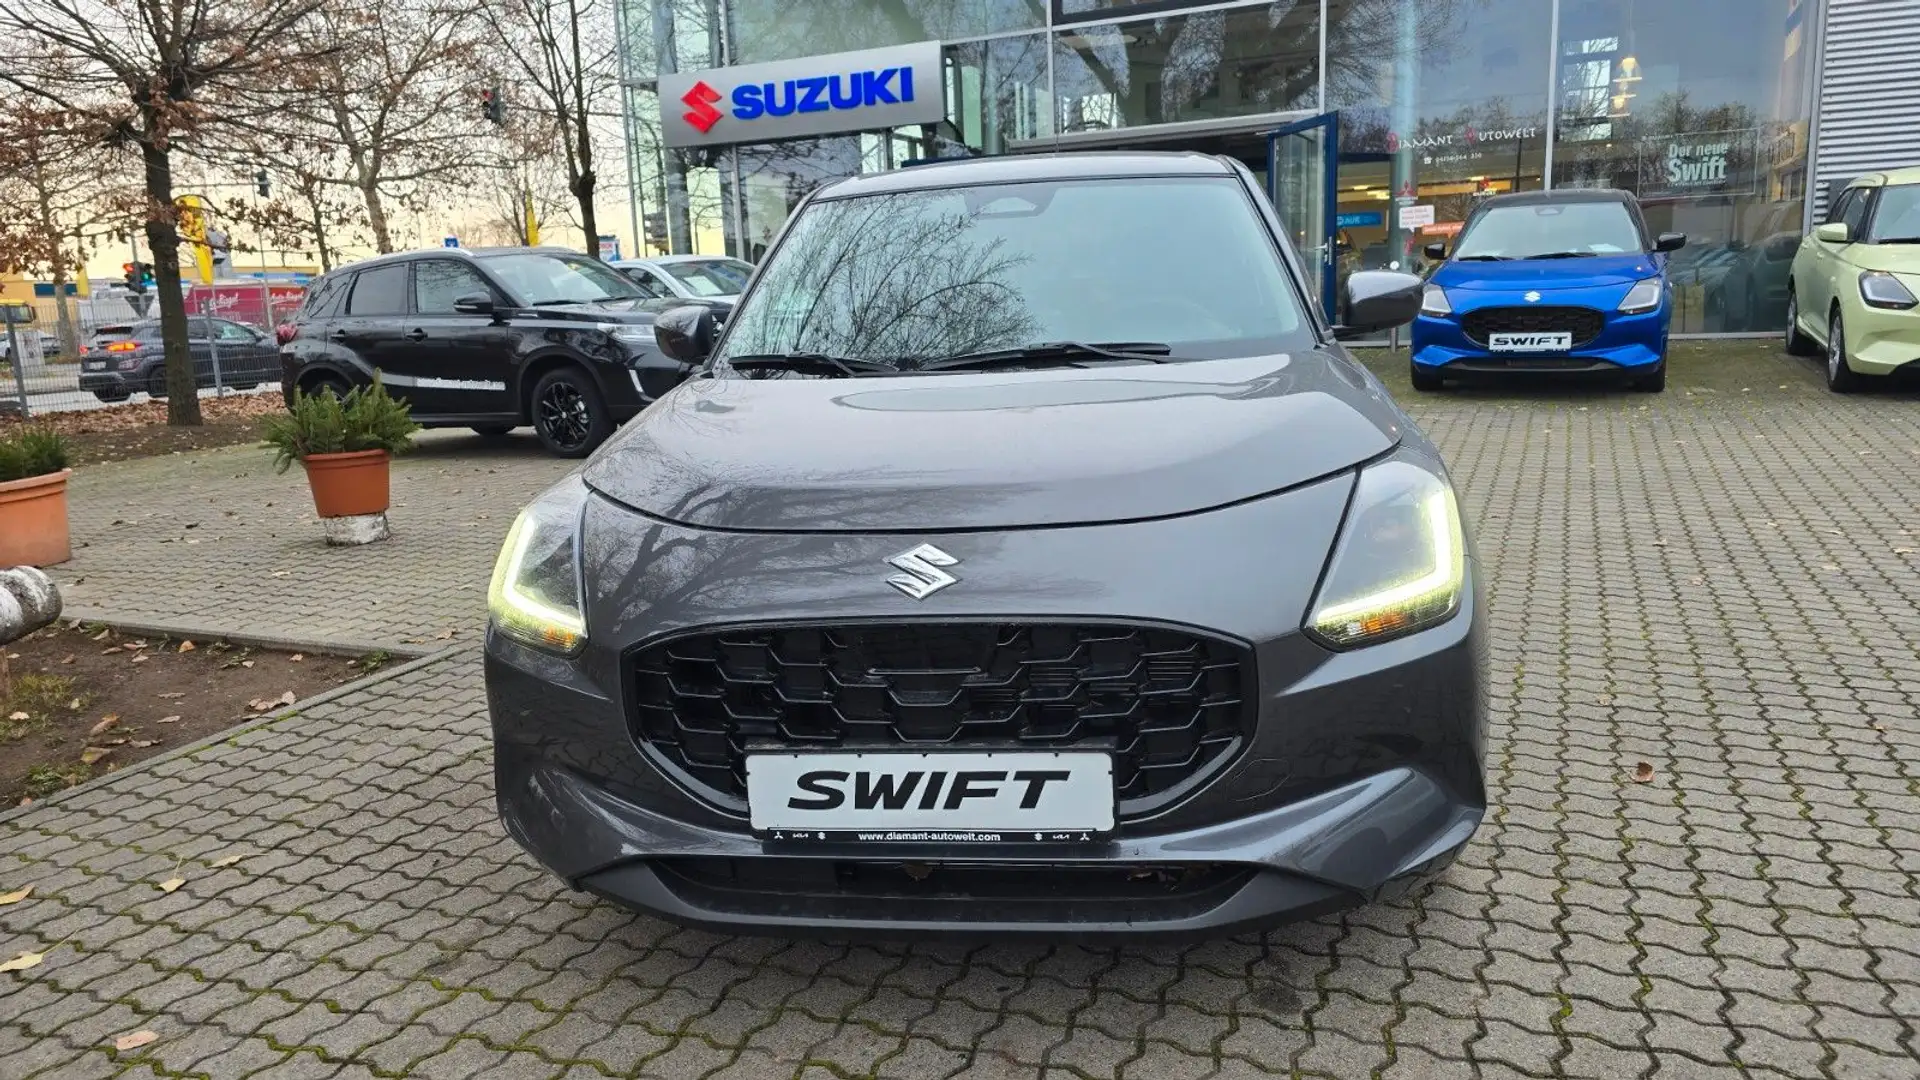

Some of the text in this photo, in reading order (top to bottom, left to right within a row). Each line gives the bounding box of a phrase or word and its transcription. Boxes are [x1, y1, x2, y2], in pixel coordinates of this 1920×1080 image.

[732, 66, 914, 120] SUZUKI
[1668, 142, 1728, 158] Der neue
[1668, 155, 1727, 182] Swift
[1493, 336, 1568, 346] SWIFT
[787, 770, 1071, 810] SWIFT
[858, 832, 1001, 841] www.diamant-autowelt.com
